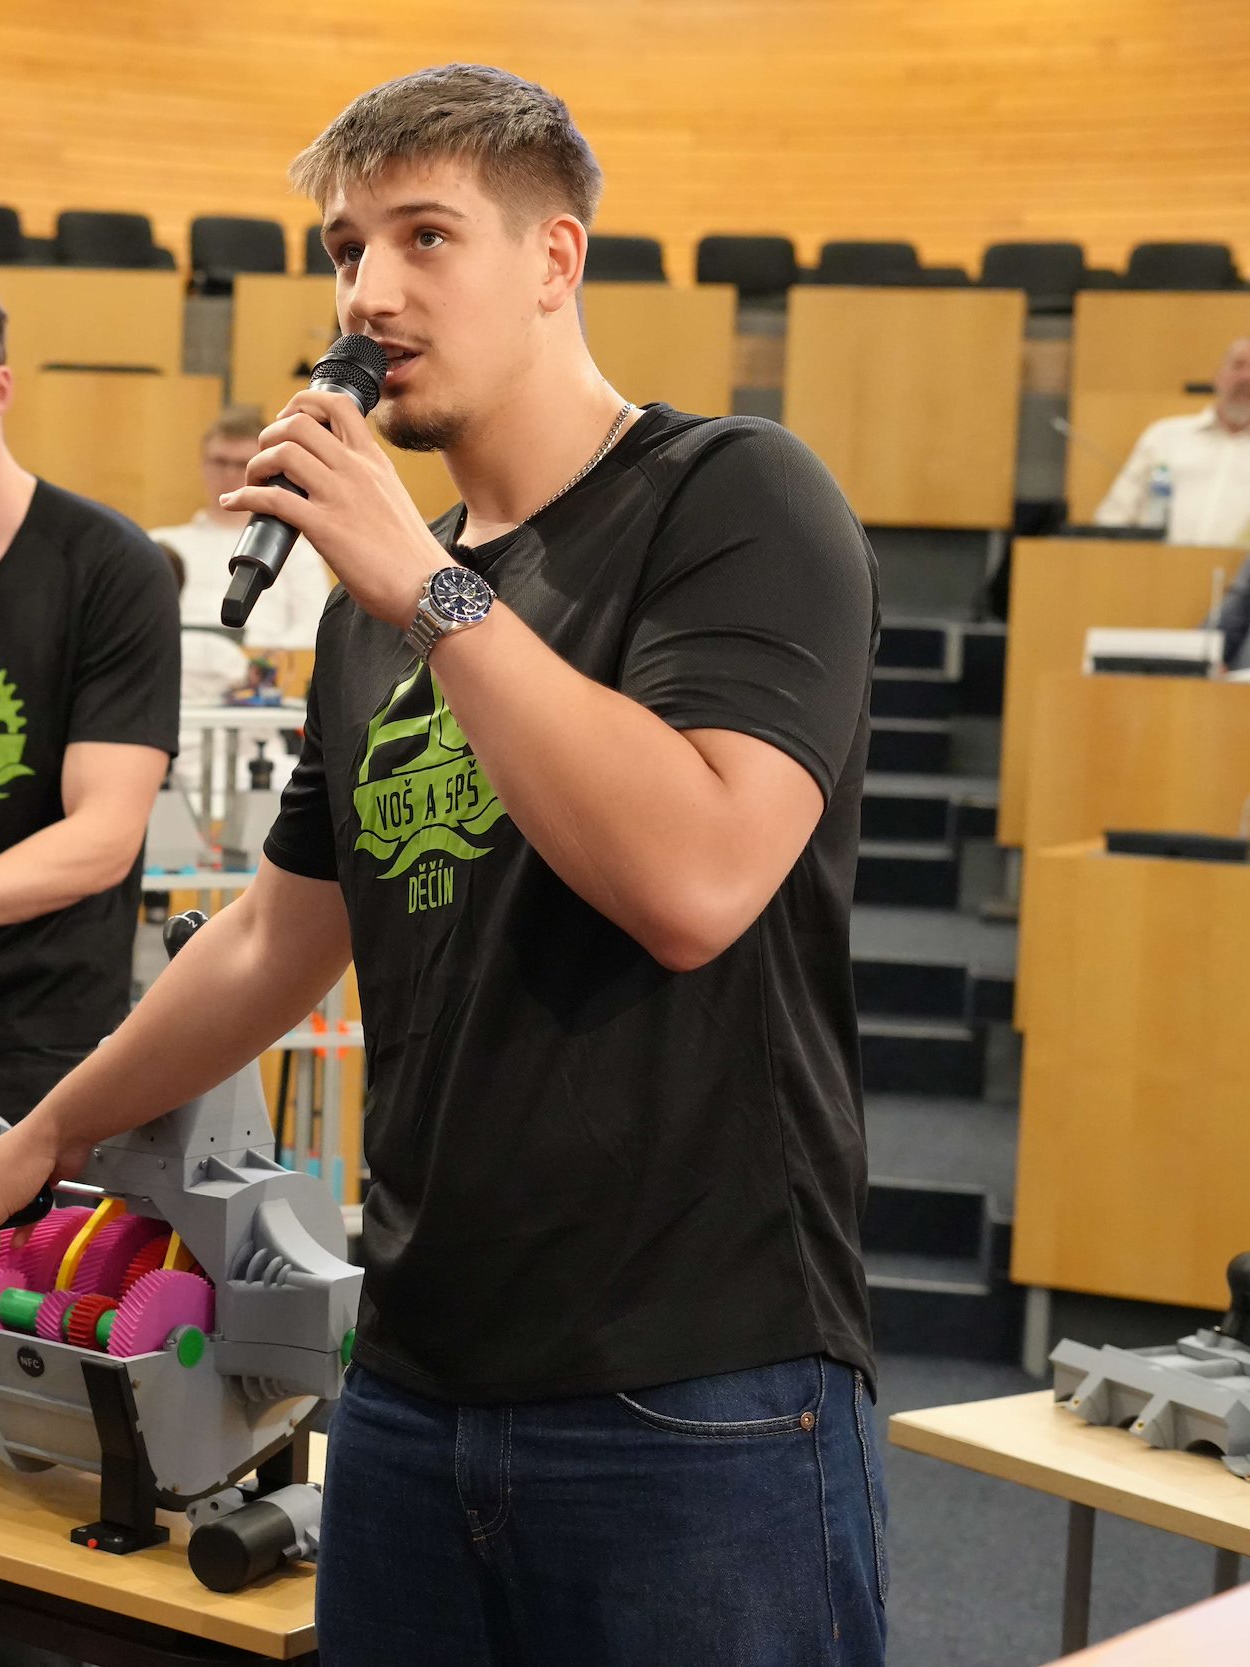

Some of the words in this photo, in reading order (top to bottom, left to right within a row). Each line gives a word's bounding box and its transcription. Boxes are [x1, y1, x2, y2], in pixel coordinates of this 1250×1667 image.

[376, 778, 414, 830] VOŠ
[424, 783, 436, 820] A
[445, 759, 478, 815] SPŠ
[408, 858, 454, 914] DĚČÍN
[20, 1355, 40, 1369] NFC
